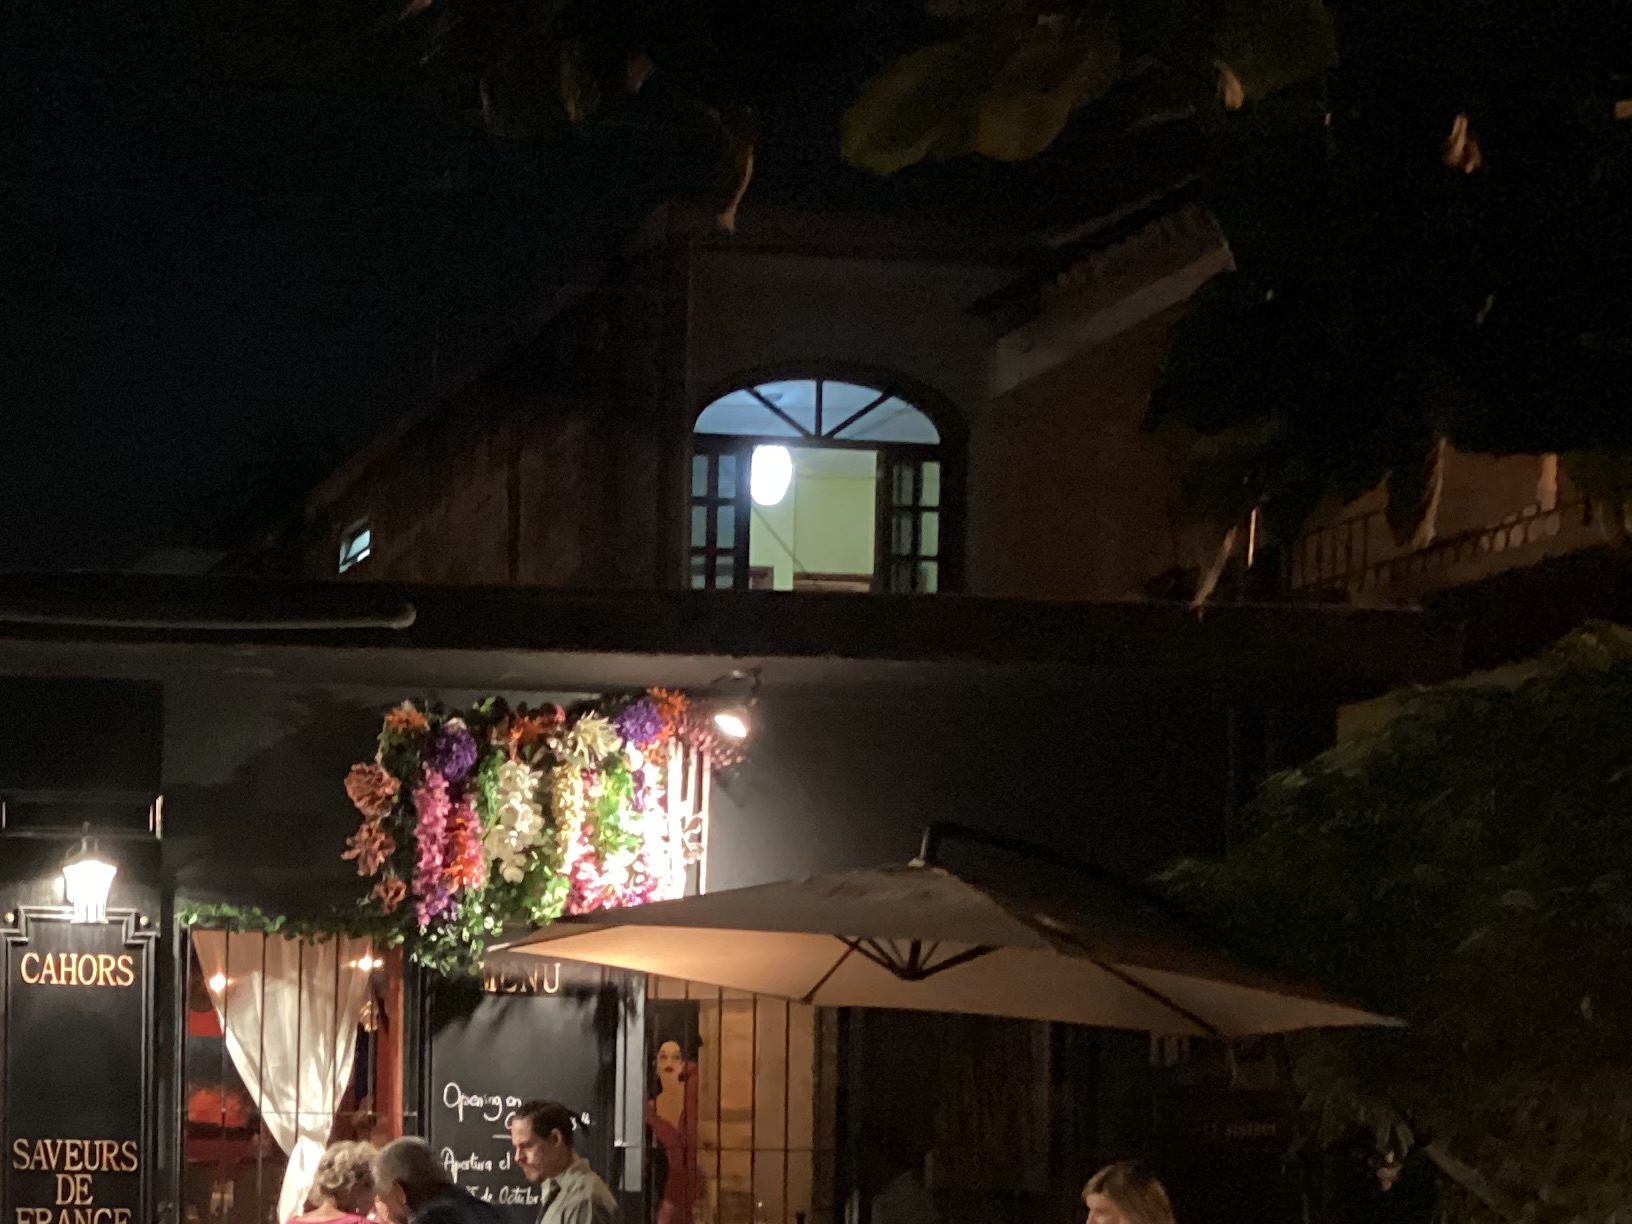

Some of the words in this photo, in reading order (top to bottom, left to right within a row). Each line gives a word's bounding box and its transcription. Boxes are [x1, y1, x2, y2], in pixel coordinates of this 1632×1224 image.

[20, 952, 135, 987] CAHORS
[443, 1082, 503, 1123] Opening
[505, 1095, 523, 1108] on
[13, 1139, 138, 1172] SAVEURS
[440, 1146, 493, 1184] Apertura
[498, 1151, 511, 1171] el
[56, 1173, 93, 1205] DE
[480, 1186, 494, 1203] de
[499, 1185, 541, 1205] Octubr
